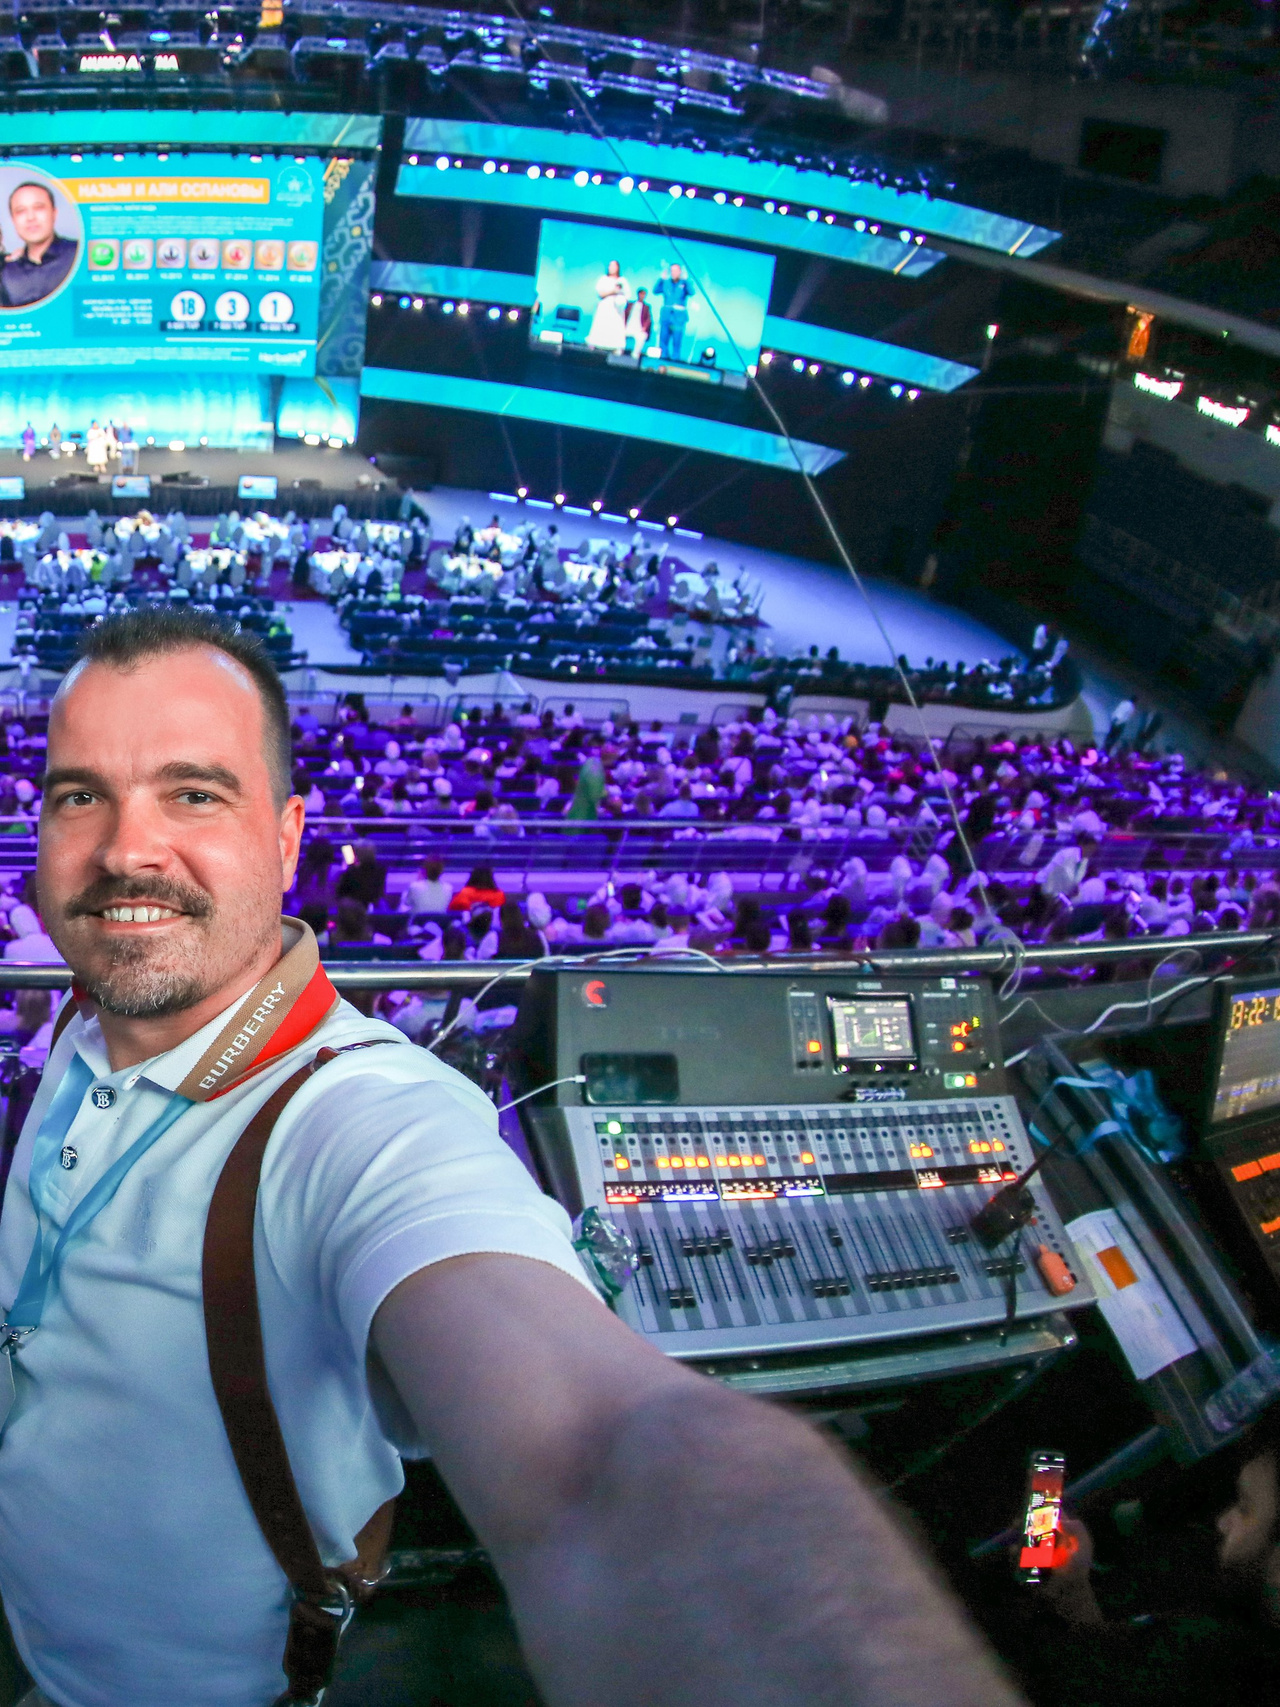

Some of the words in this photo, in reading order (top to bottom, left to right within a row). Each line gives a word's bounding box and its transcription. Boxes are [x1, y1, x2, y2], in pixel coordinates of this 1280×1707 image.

[78, 182, 132, 198] НАЗЫМ
[135, 182, 145, 197] И
[148, 182, 178, 197] АЛИ
[181, 182, 264, 198] ОСПАНОВЫ
[180, 298, 195, 315] 18
[227, 298, 237, 316] 3
[271, 299, 278, 317] 1
[199, 981, 286, 1090] BURBERRY
